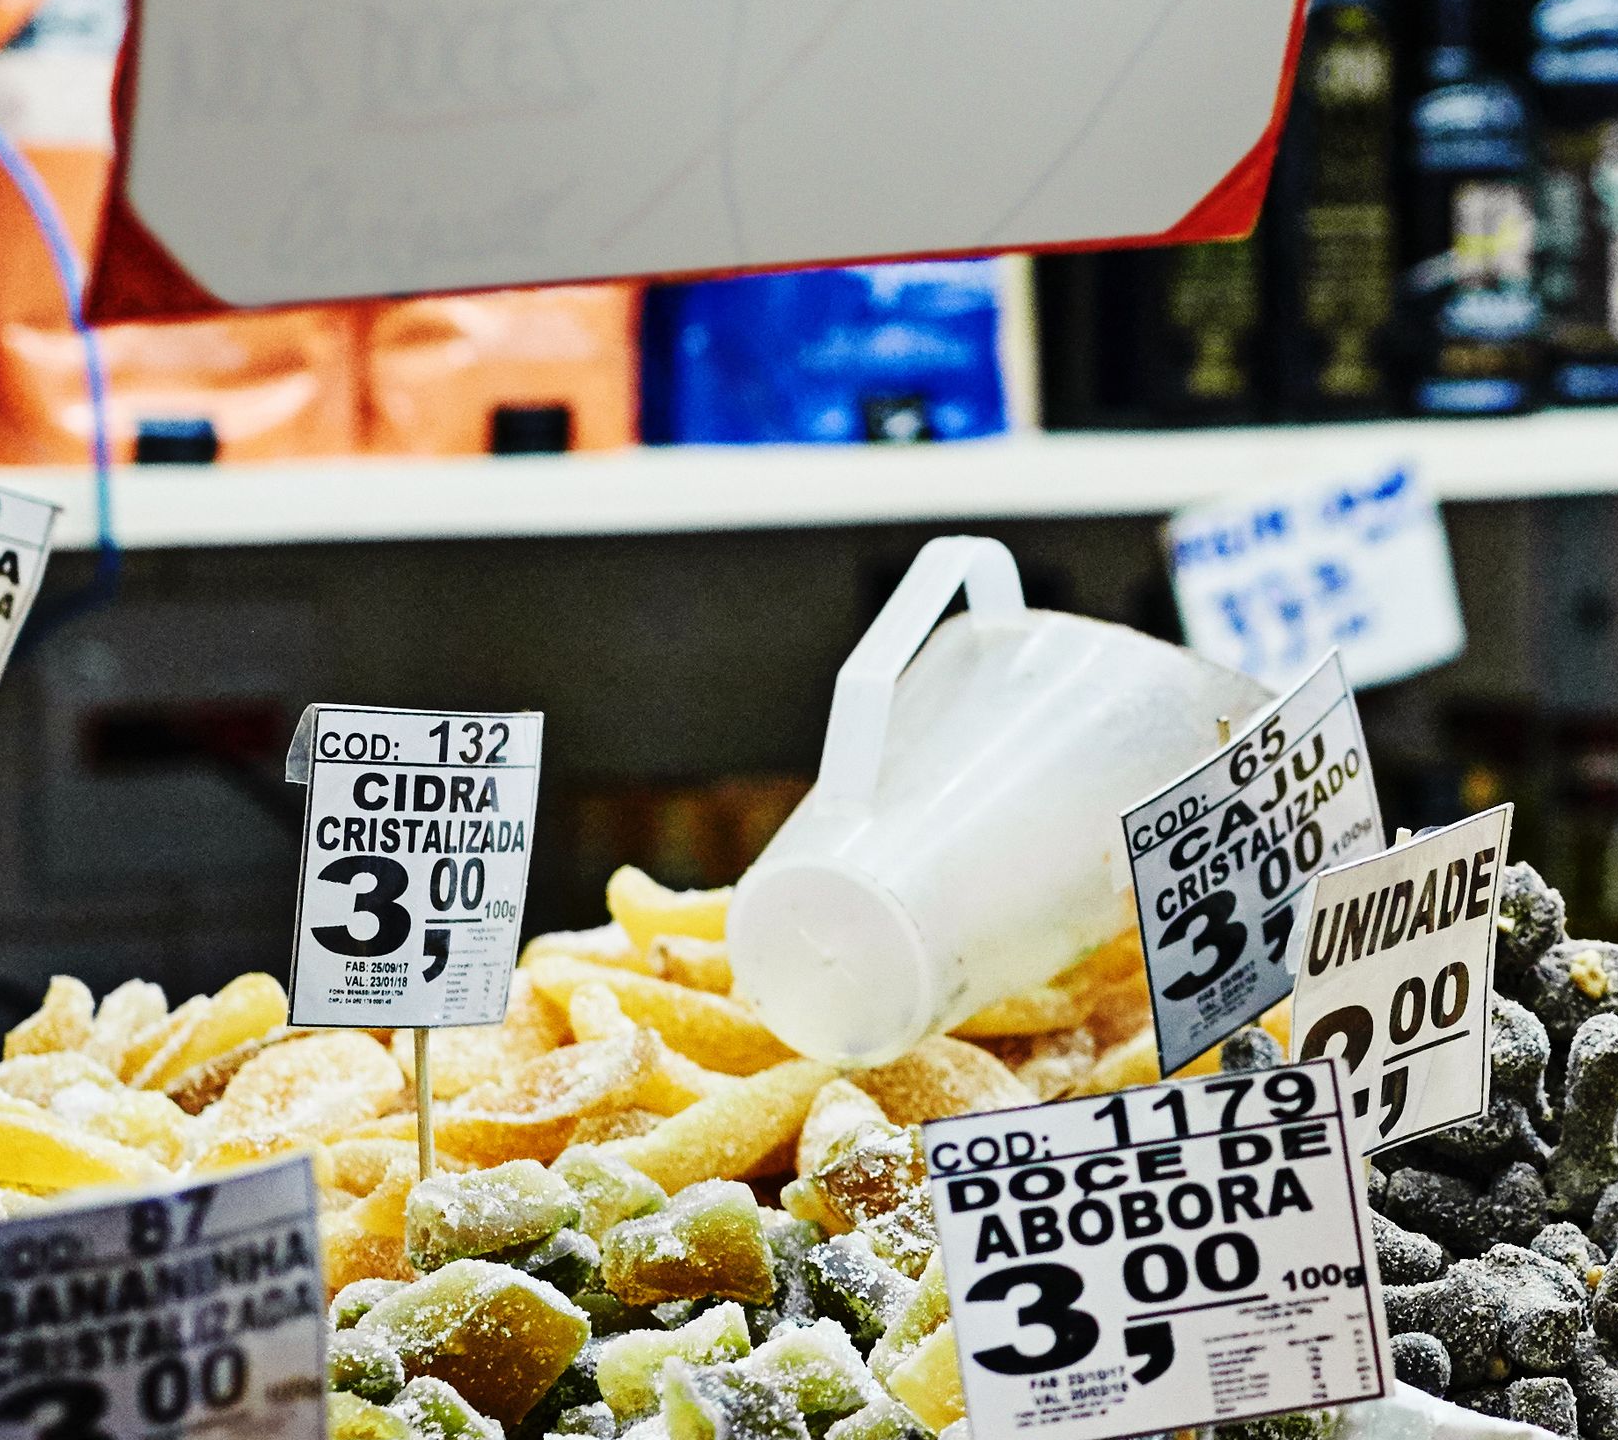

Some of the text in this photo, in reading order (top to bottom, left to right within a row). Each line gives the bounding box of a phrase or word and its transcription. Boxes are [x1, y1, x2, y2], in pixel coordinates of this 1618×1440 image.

[319, 720, 510, 764] COD: 132
[352, 772, 500, 813] CIDRA
[1132, 715, 1285, 851] COD: 65
[1169, 733, 1326, 872] CAJU
[316, 816, 525, 854] CRISTALIZADA
[1156, 748, 1360, 921] CRISTALIZADO
[484, 900, 516, 923] 100g
[1308, 847, 1496, 977] UNIDADE
[345, 961, 370, 973] FAB:
[345, 976, 369, 987] VAL:
[930, 1071, 1317, 1172] COD: 1179
[947, 1123, 1333, 1214] DOCE DE
[975, 1168, 1314, 1263] ABÓBORA
[1282, 1264, 1366, 1293] 100g
